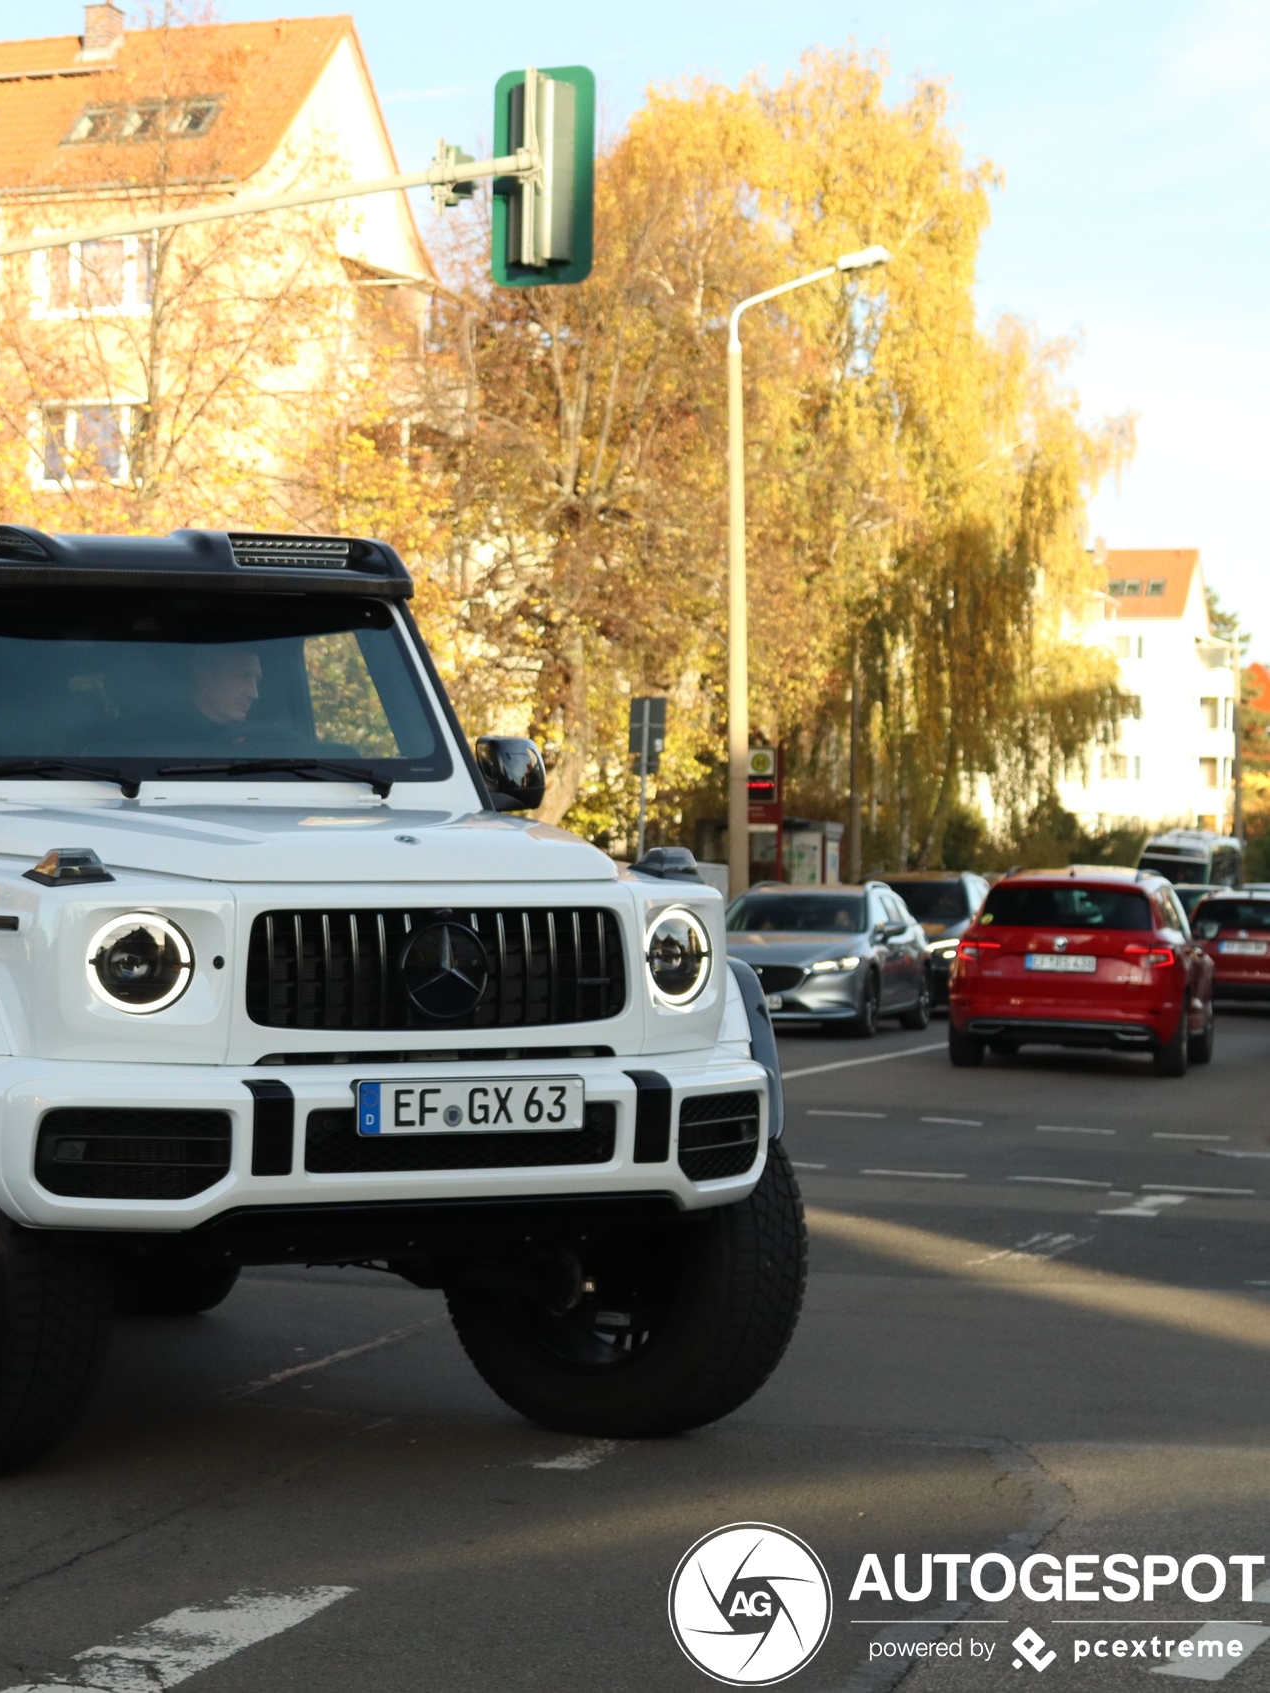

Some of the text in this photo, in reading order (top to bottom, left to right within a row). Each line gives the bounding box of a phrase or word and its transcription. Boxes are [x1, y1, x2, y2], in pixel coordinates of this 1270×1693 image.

[394, 1085, 567, 1127] EF GX 63
[365, 1114, 375, 1126] D
